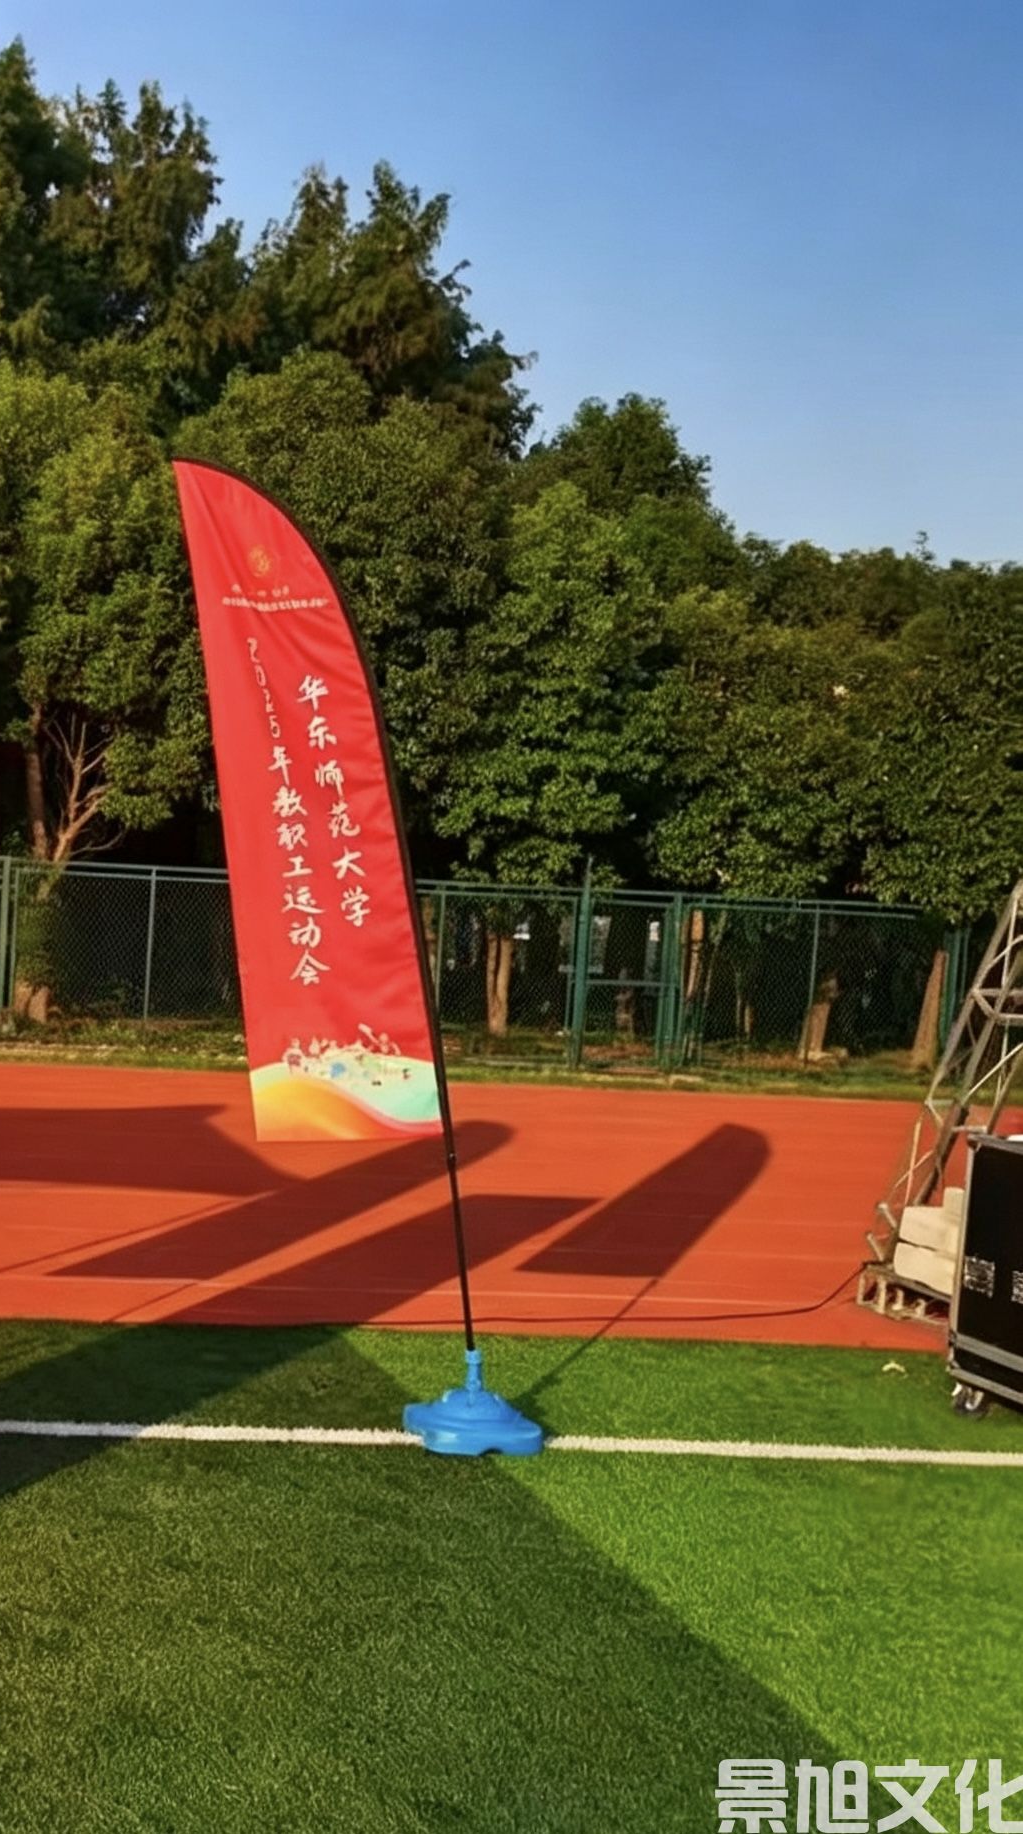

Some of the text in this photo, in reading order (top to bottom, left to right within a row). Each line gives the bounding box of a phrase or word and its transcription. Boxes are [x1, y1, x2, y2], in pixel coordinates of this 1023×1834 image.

[296, 674, 372, 927] 华东师范大学
